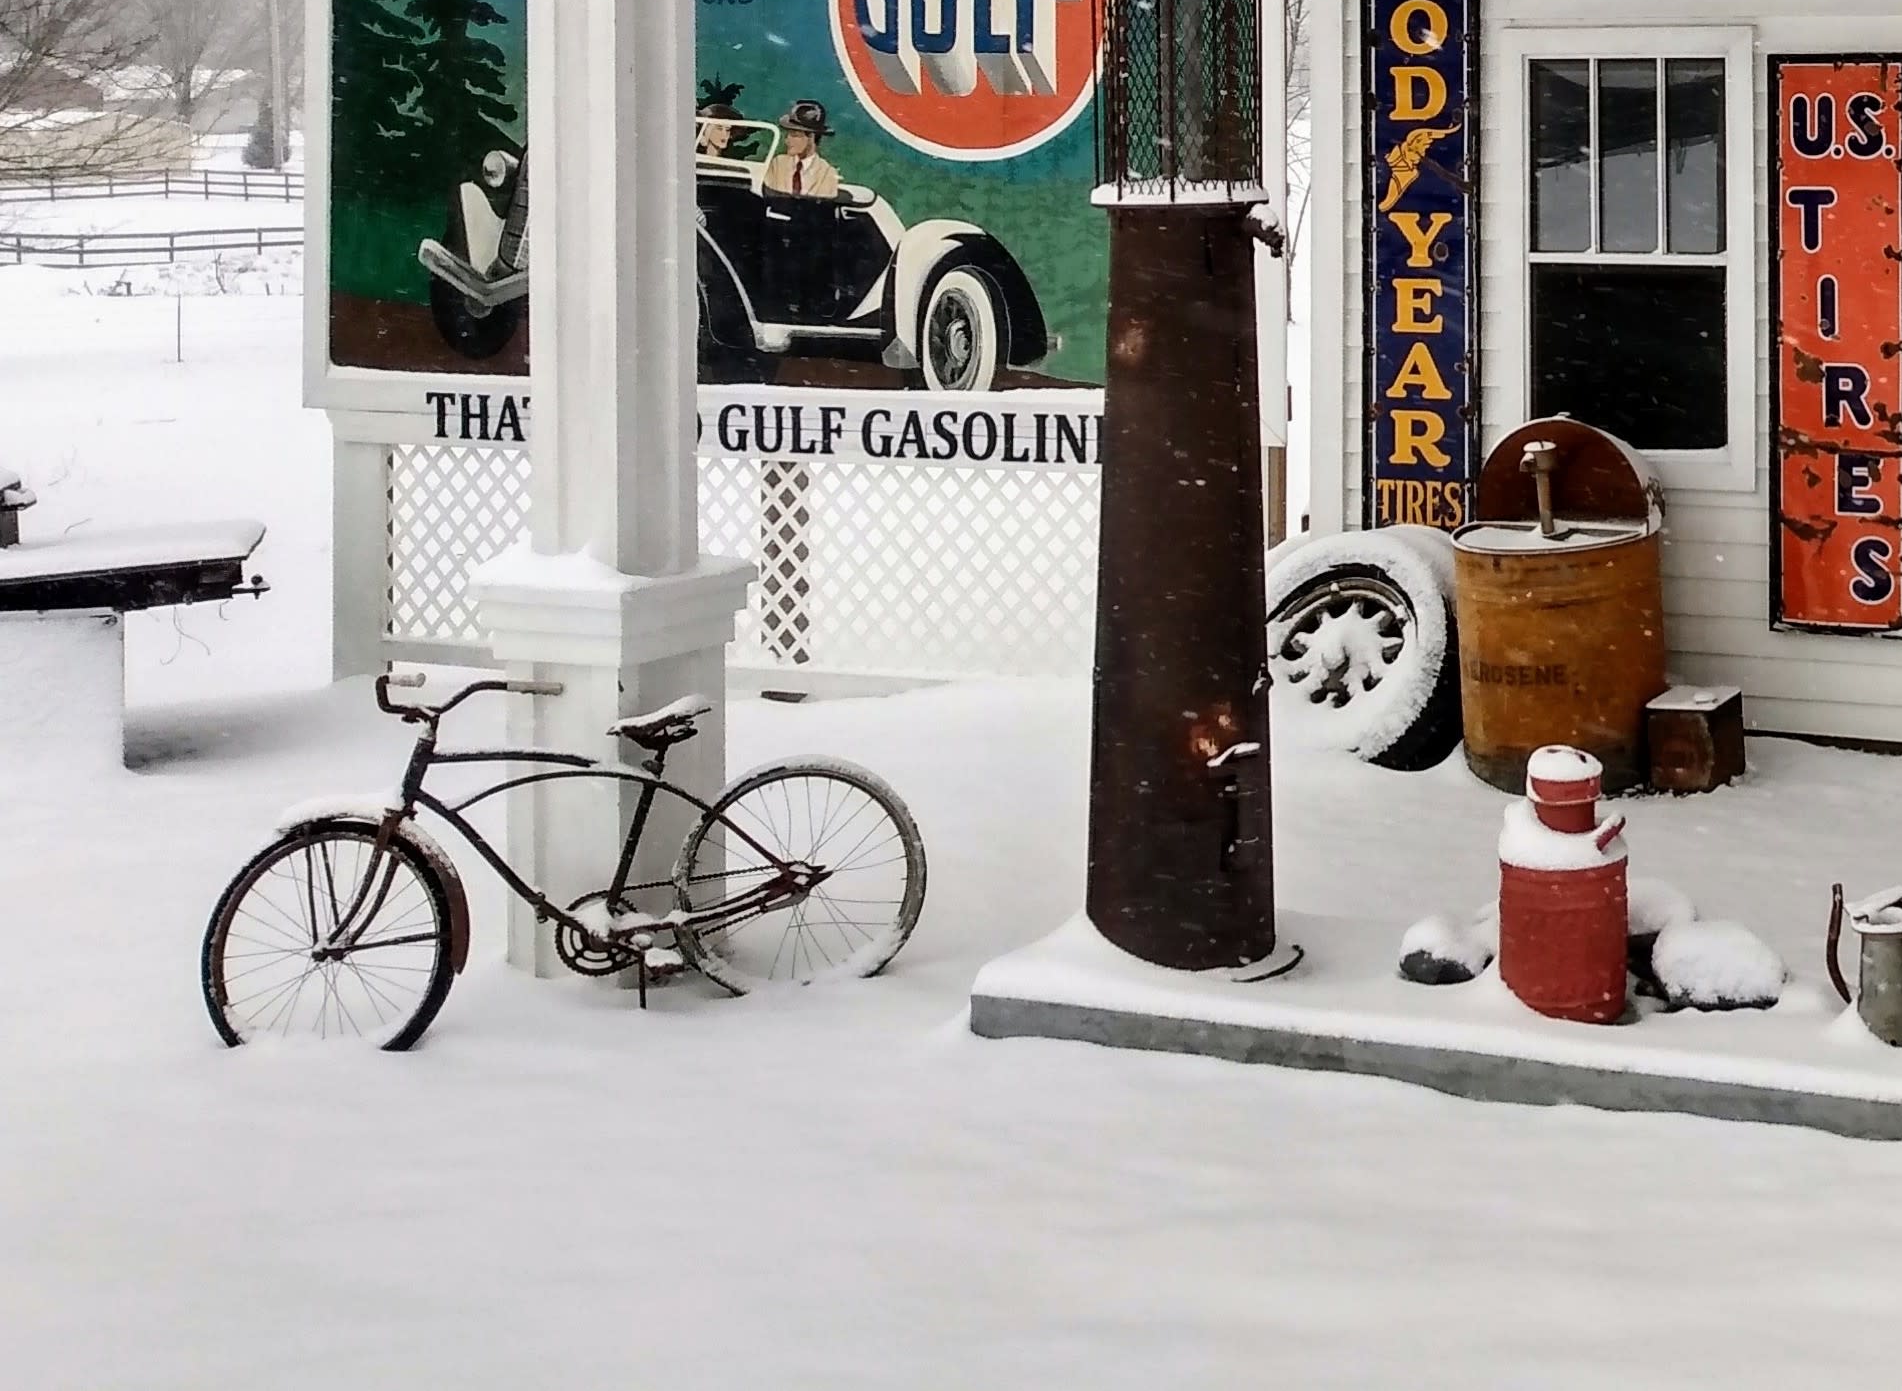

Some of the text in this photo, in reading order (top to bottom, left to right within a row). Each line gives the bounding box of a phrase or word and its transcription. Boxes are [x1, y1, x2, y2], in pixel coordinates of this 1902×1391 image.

[1789, 91, 1896, 159] U.S.
[1785, 186, 1895, 606] TIRES
[717, 403, 847, 455] GULF
[1377, 478, 1463, 527] TIRES
